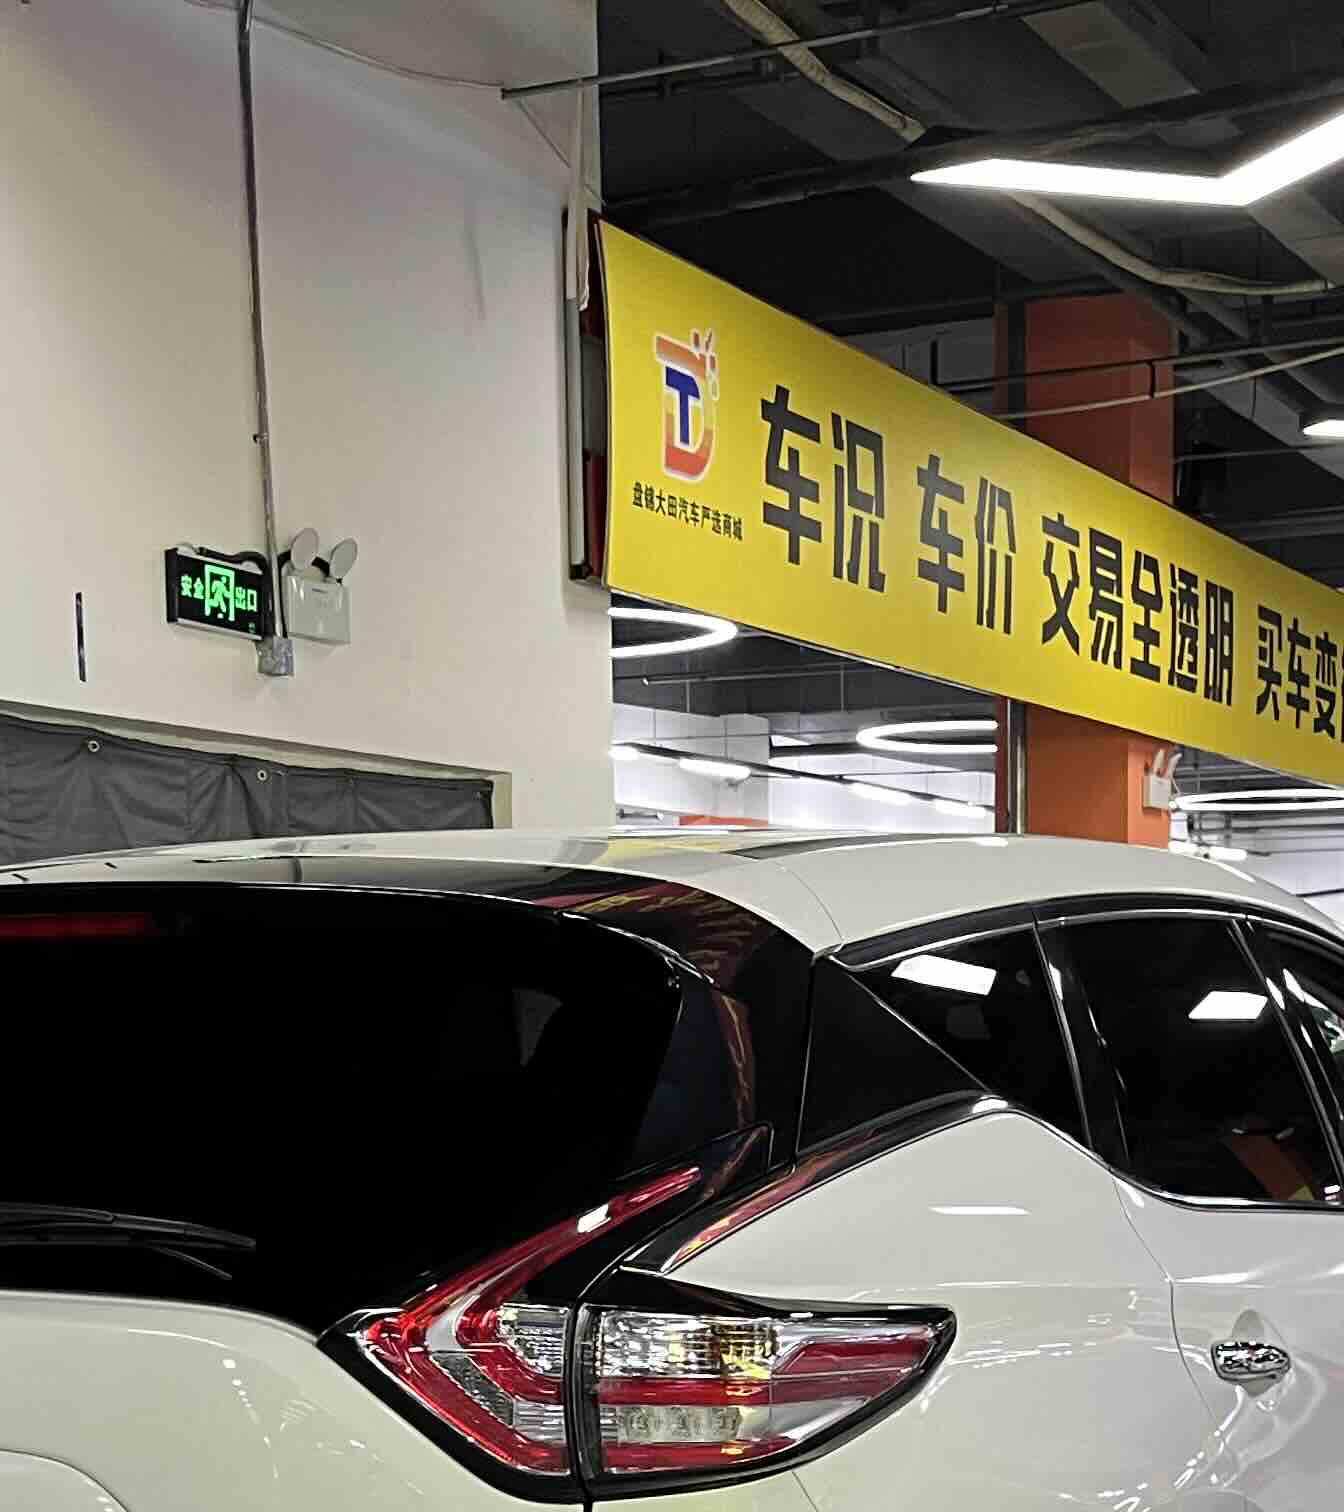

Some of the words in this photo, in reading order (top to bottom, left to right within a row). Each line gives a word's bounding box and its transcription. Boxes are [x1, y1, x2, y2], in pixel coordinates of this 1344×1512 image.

[180, 574, 204, 600] 安全
[235, 586, 257, 612] 出口
[761, 385, 886, 593] 车况
[917, 454, 1017, 635] 车价
[1040, 512, 1234, 708] 交易全透明
